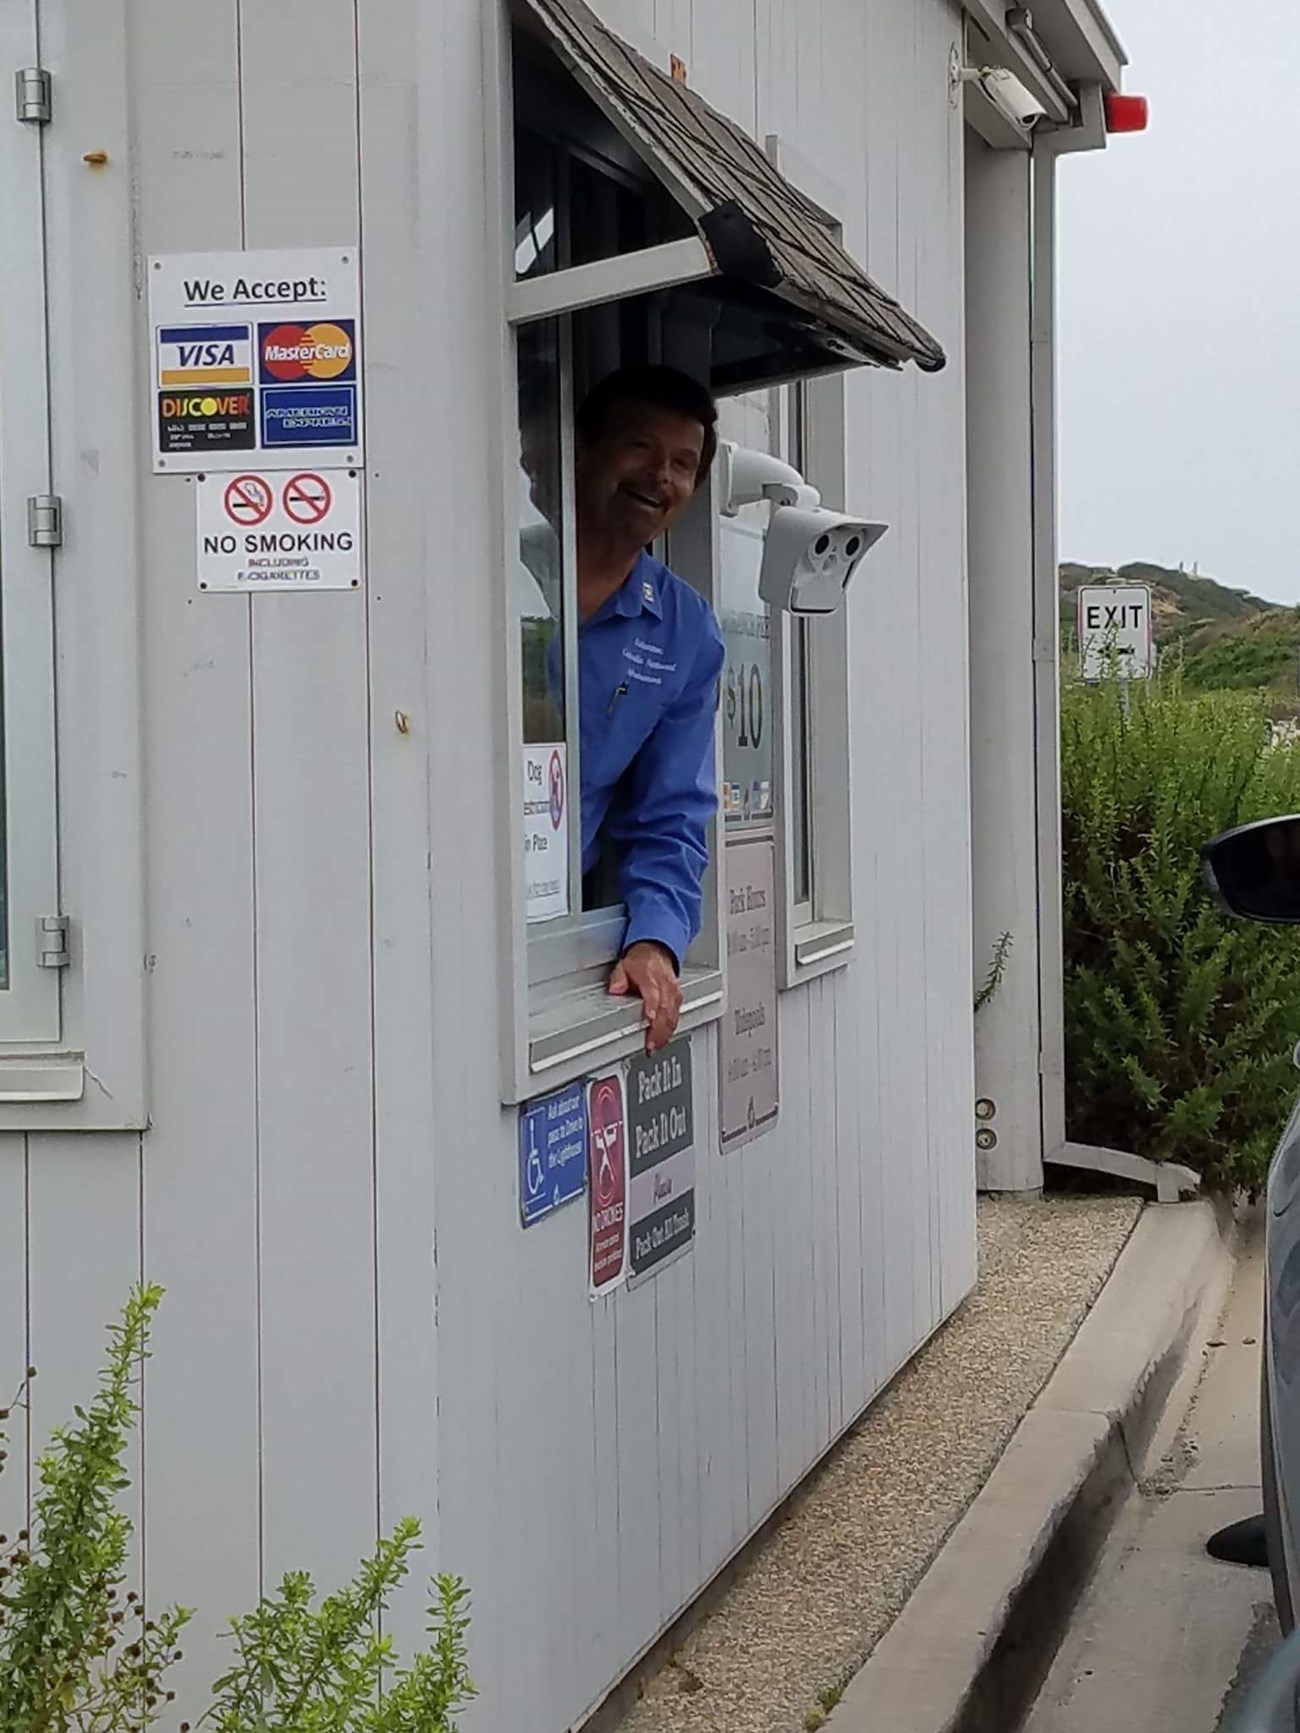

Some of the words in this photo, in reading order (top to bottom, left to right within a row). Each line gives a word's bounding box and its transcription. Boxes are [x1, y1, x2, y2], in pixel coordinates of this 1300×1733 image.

[184, 280, 225, 301] We
[232, 276, 327, 302] Accept:
[177, 343, 236, 367] VISA
[265, 342, 351, 361] MasterCard
[162, 395, 250, 418] DISCOVER
[204, 535, 237, 554] NO
[244, 532, 353, 553] SMOKING
[1087, 605, 1143, 629] EXIT
[727, 662, 763, 750] $10
[638, 1063, 662, 1104] Pack
[662, 1060, 671, 1092] It
[671, 1056, 682, 1088] In
[635, 1117, 660, 1158] Pack
[660, 1112, 669, 1146] It
[669, 1106, 687, 1139] Out
